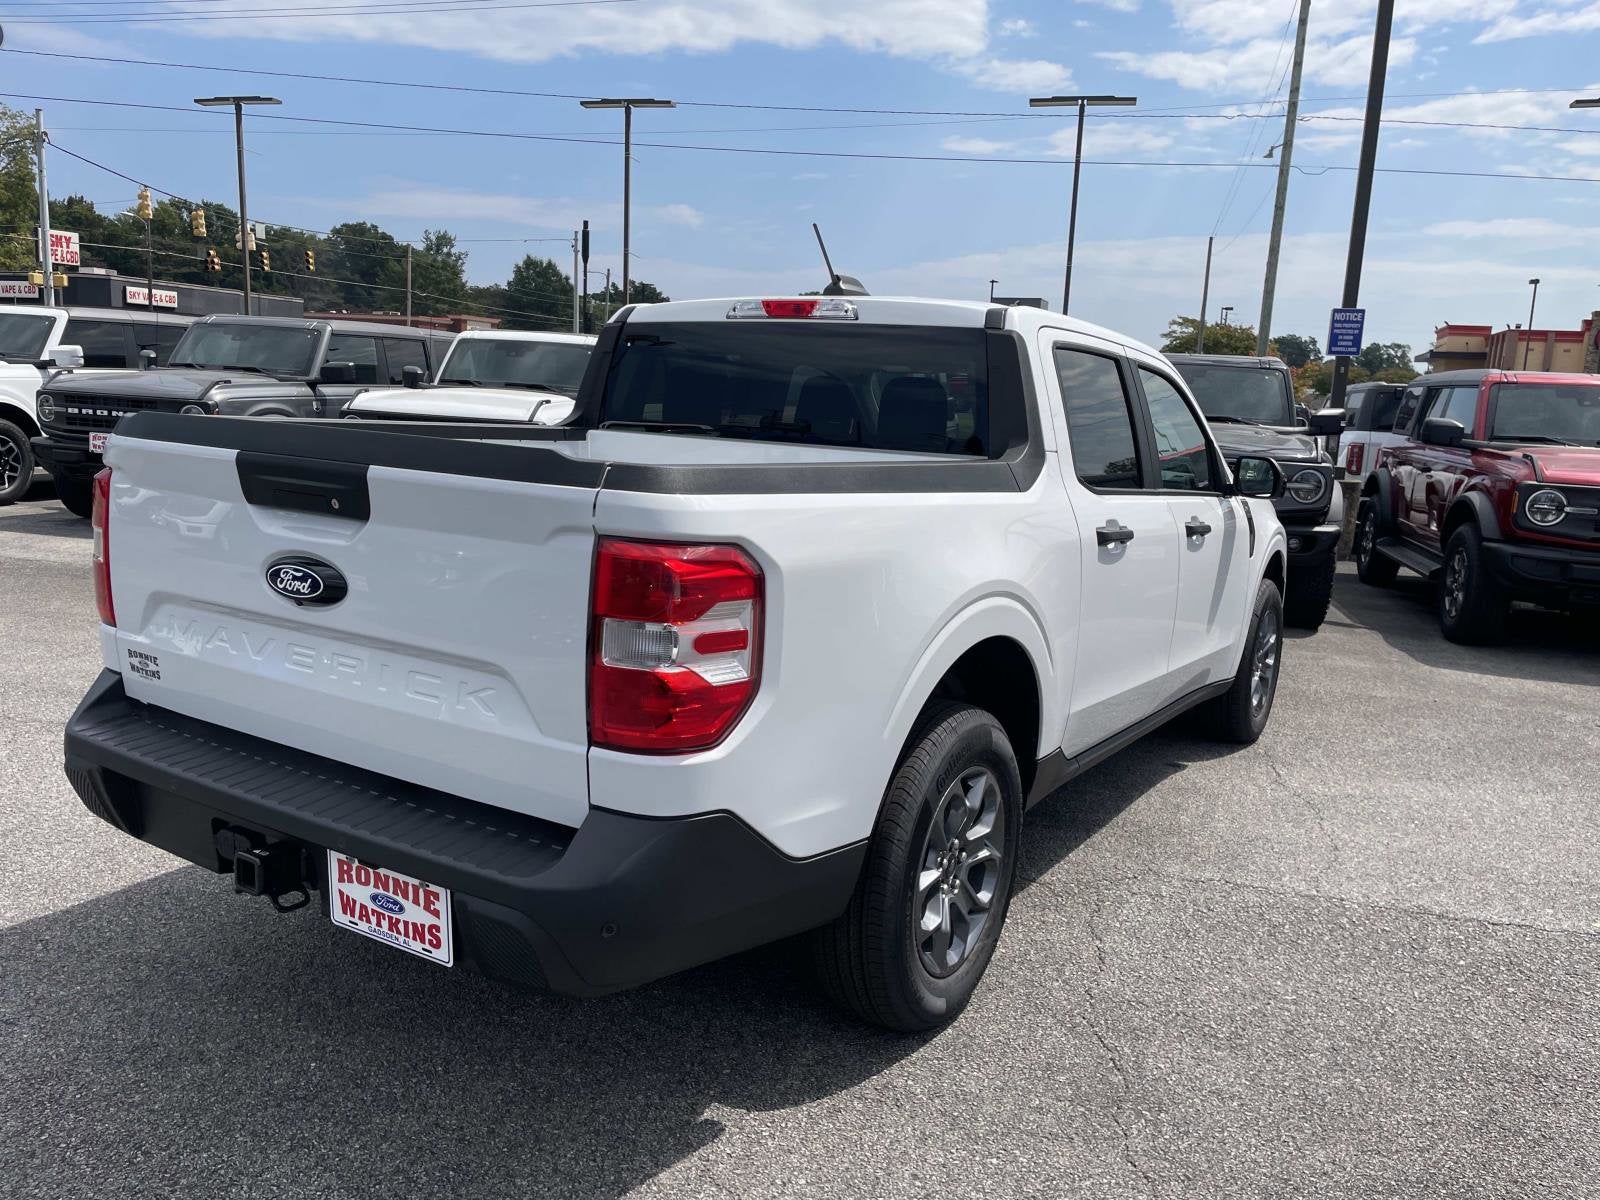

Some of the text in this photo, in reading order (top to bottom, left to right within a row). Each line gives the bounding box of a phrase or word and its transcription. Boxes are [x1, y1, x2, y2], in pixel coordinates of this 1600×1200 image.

[49, 233, 72, 249] SKY
[50, 248, 79, 264] PE & CBD
[1, 284, 17, 294] VAPE
[23, 284, 37, 295] CBD
[128, 290, 141, 300] SKY
[164, 294, 177, 304] CBD
[1334, 313, 1363, 321] NOTICE
[67, 408, 124, 416] BRON
[277, 568, 312, 594] Ford
[127, 648, 159, 667] RONNIE
[129, 661, 161, 680] WATKINS
[168, 614, 497, 718] MAVERICK
[336, 857, 441, 920] RONNIE
[338, 888, 442, 950] WATKINS
[402, 939, 412, 948] AL
